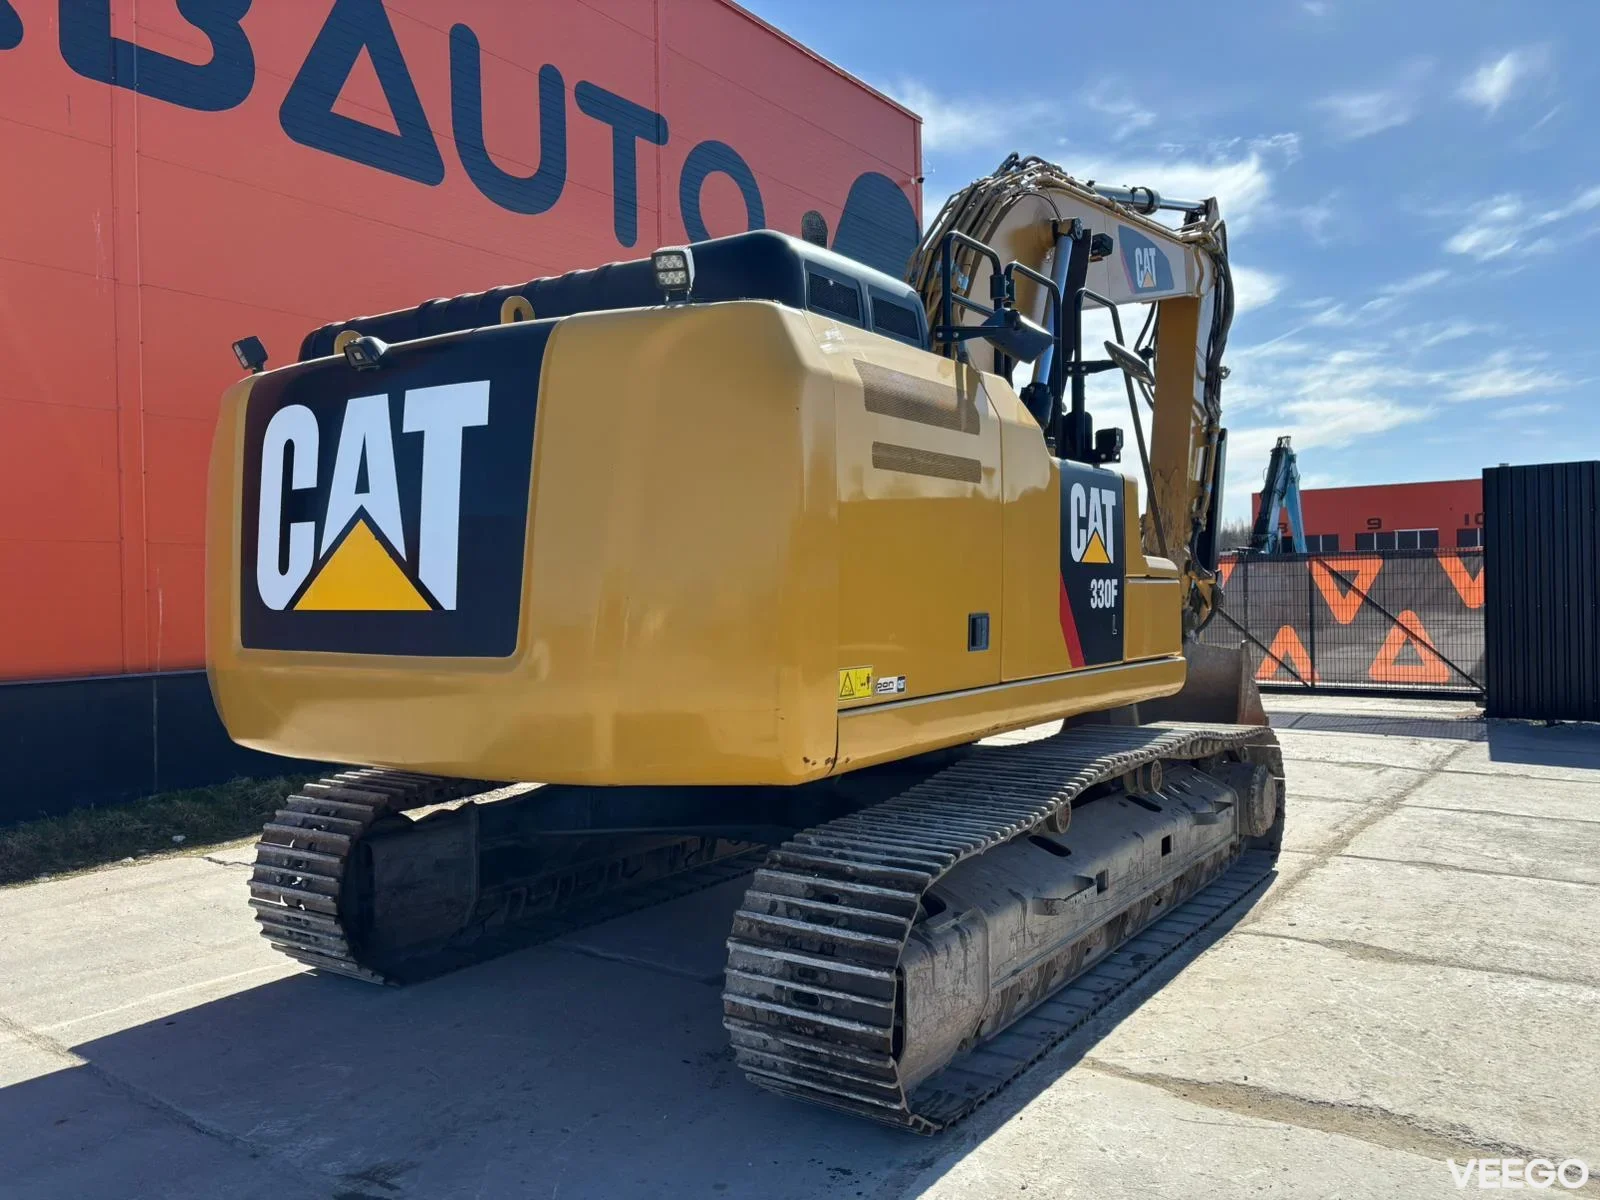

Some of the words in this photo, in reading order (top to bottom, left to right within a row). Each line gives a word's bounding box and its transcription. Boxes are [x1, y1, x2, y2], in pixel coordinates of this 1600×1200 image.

[1135, 247, 1157, 288] CAT
[257, 380, 490, 610] CAT
[1070, 482, 1116, 564] CAT
[1366, 517, 1382, 530] 9
[1090, 578, 1118, 609] 330F
